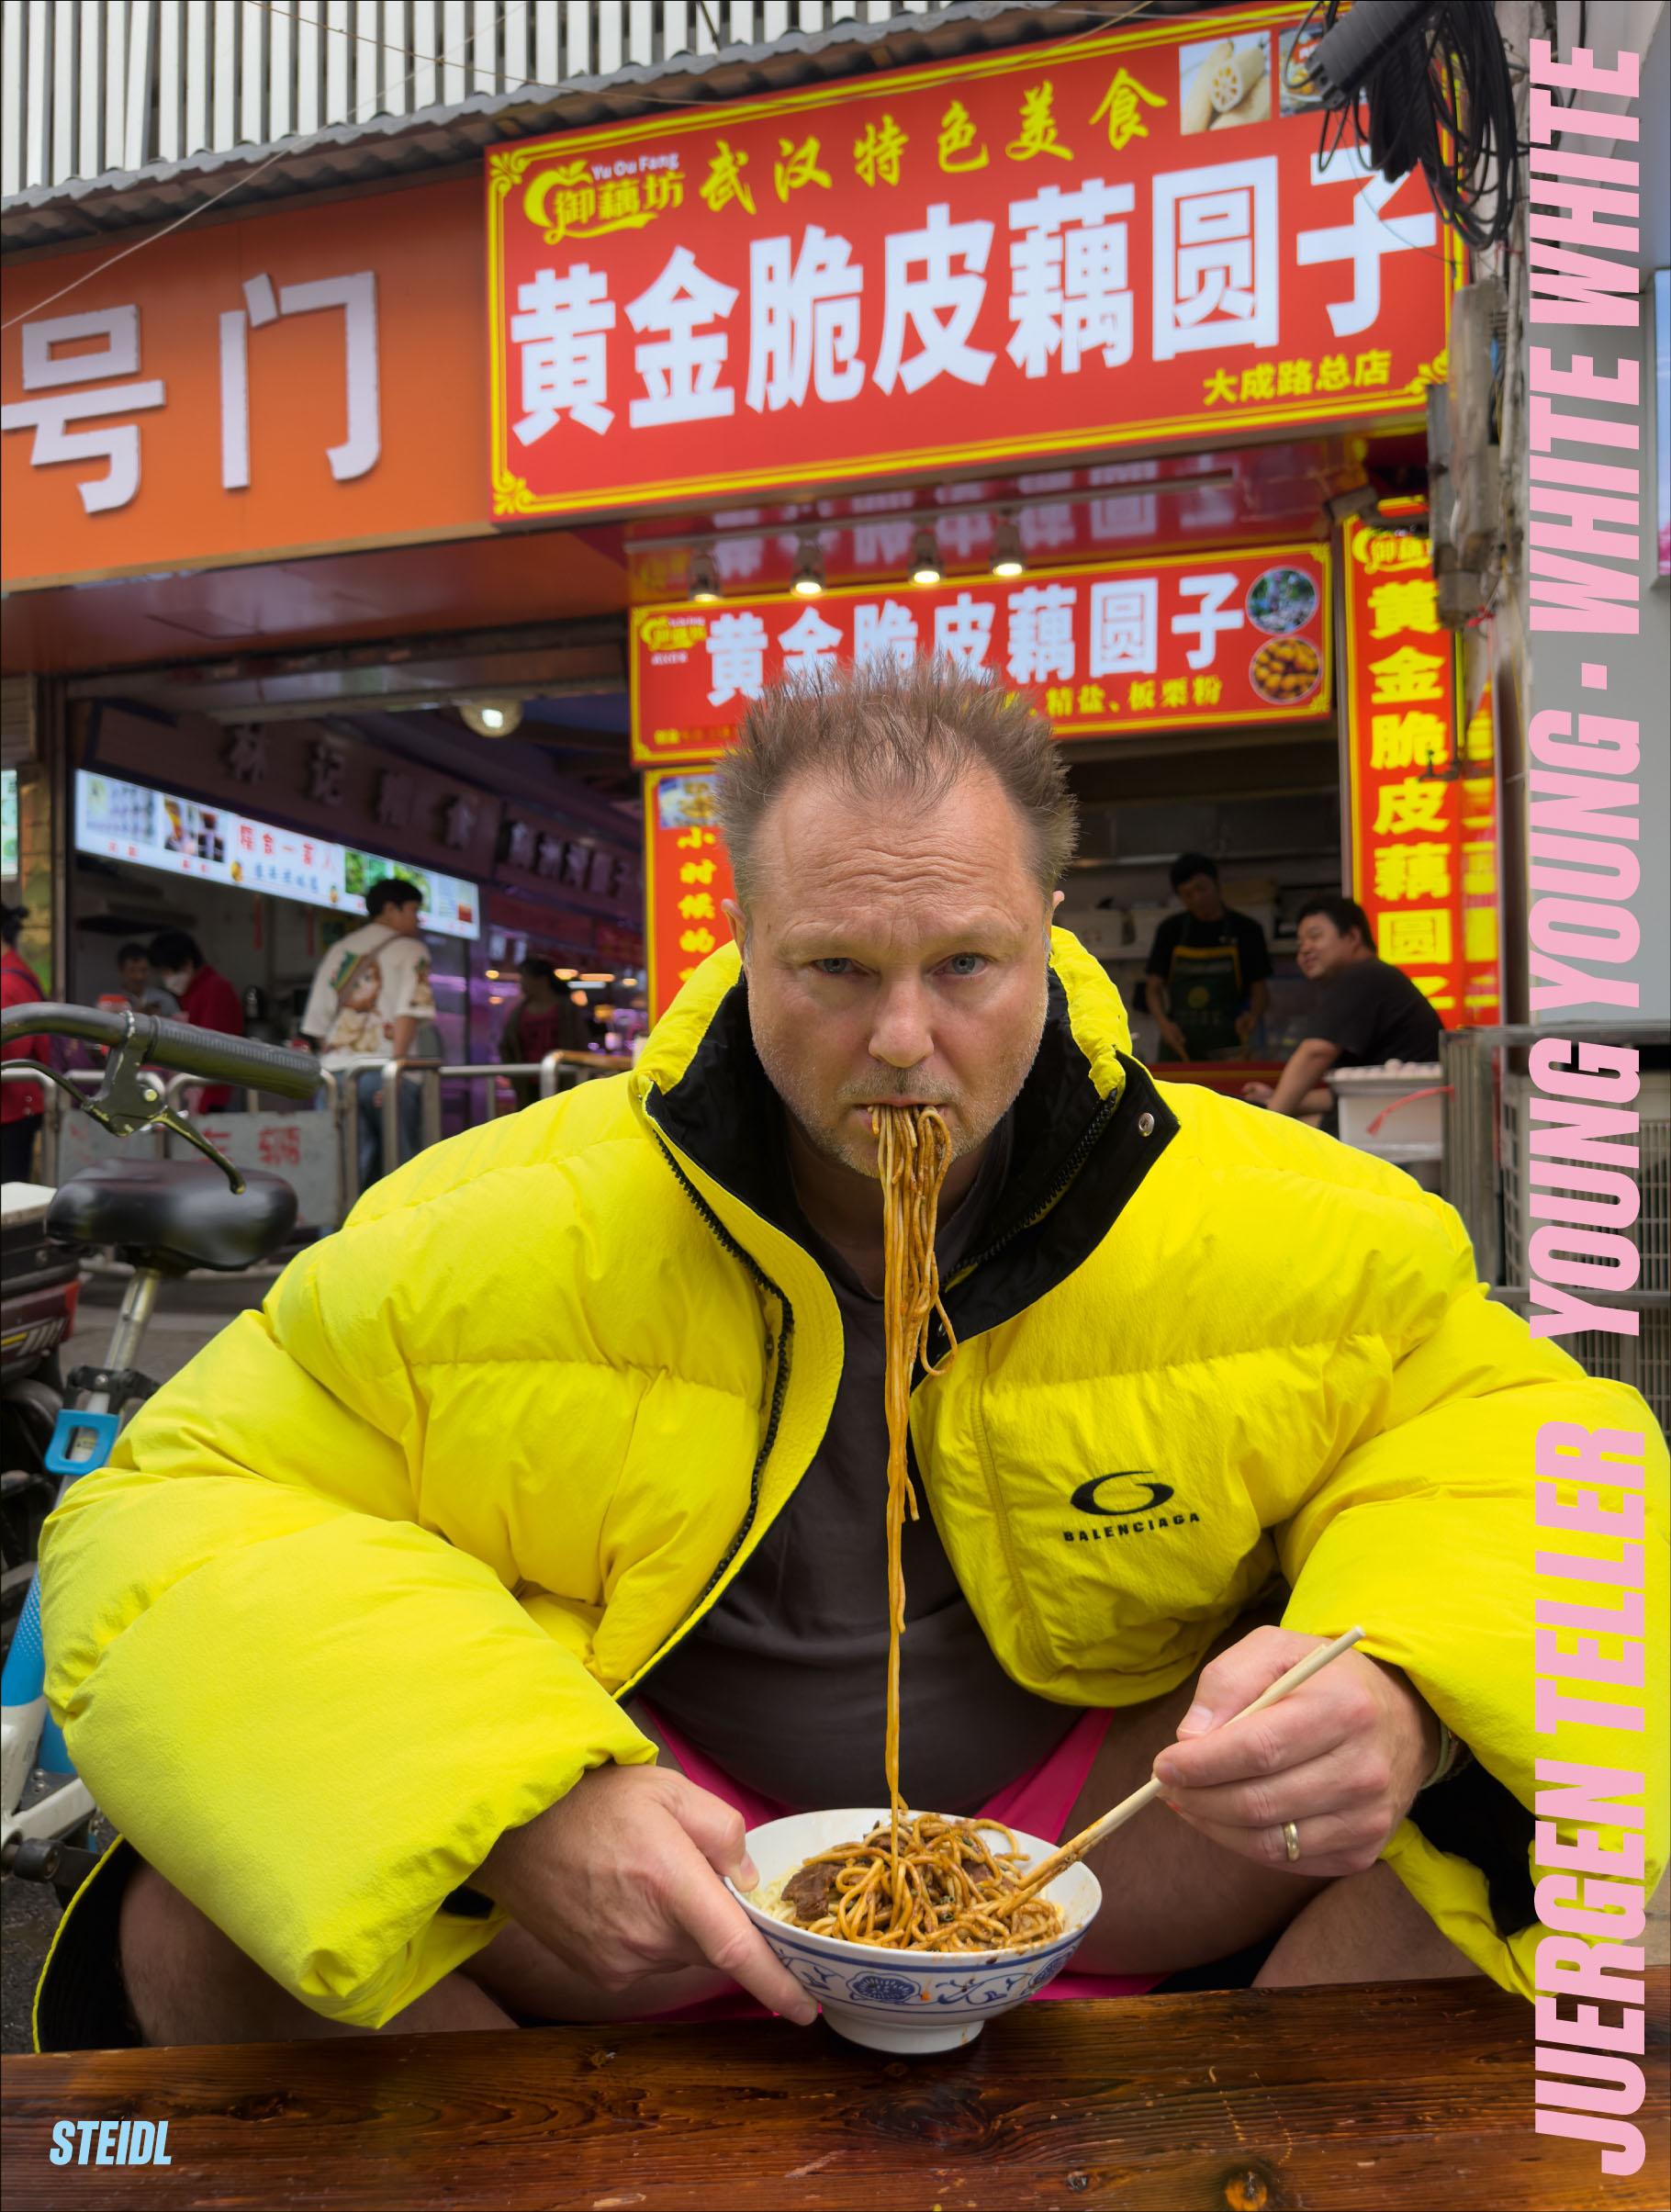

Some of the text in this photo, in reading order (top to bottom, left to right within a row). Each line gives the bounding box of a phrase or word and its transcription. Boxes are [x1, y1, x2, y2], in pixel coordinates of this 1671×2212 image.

[700, 66, 1168, 216] 武汉特色美食
[510, 144, 1437, 446] 黄金脆皮藕圆子
[0, 270, 381, 515] 号门
[1203, 349, 1392, 407] 大成路总店
[1062, 1512, 1200, 1542] BALENCIAGA
